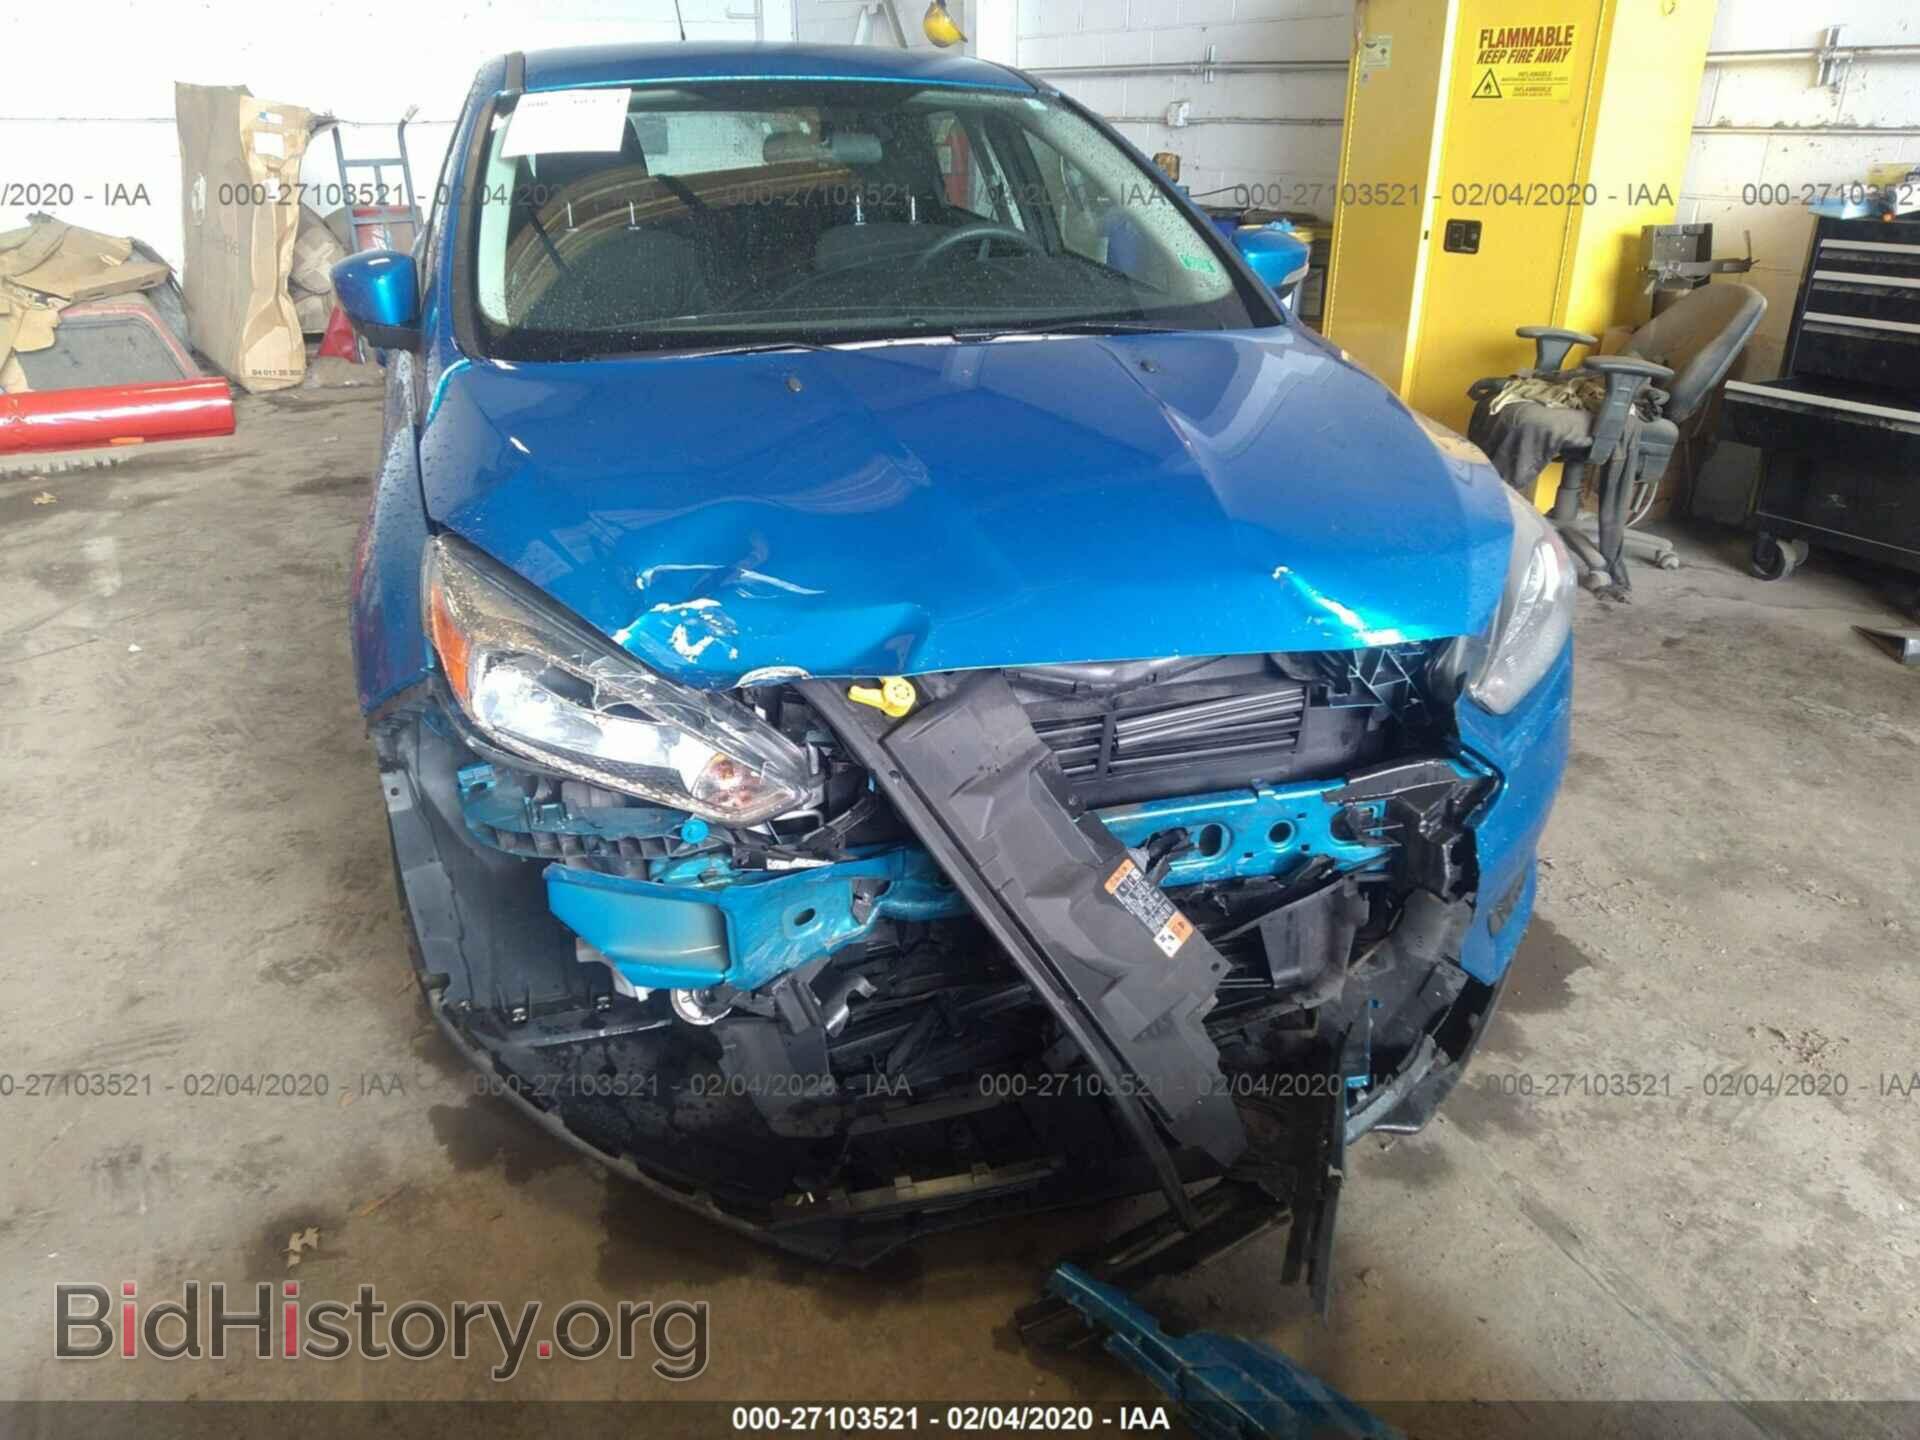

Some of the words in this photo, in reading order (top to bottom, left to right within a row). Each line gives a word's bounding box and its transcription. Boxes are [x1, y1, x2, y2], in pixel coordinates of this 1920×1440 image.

[1479, 25, 1575, 49] FLAMMABLE
[1477, 49, 1508, 64] KEEP
[1507, 48, 1536, 64] FIRE
[1534, 47, 1571, 64] AWAY
